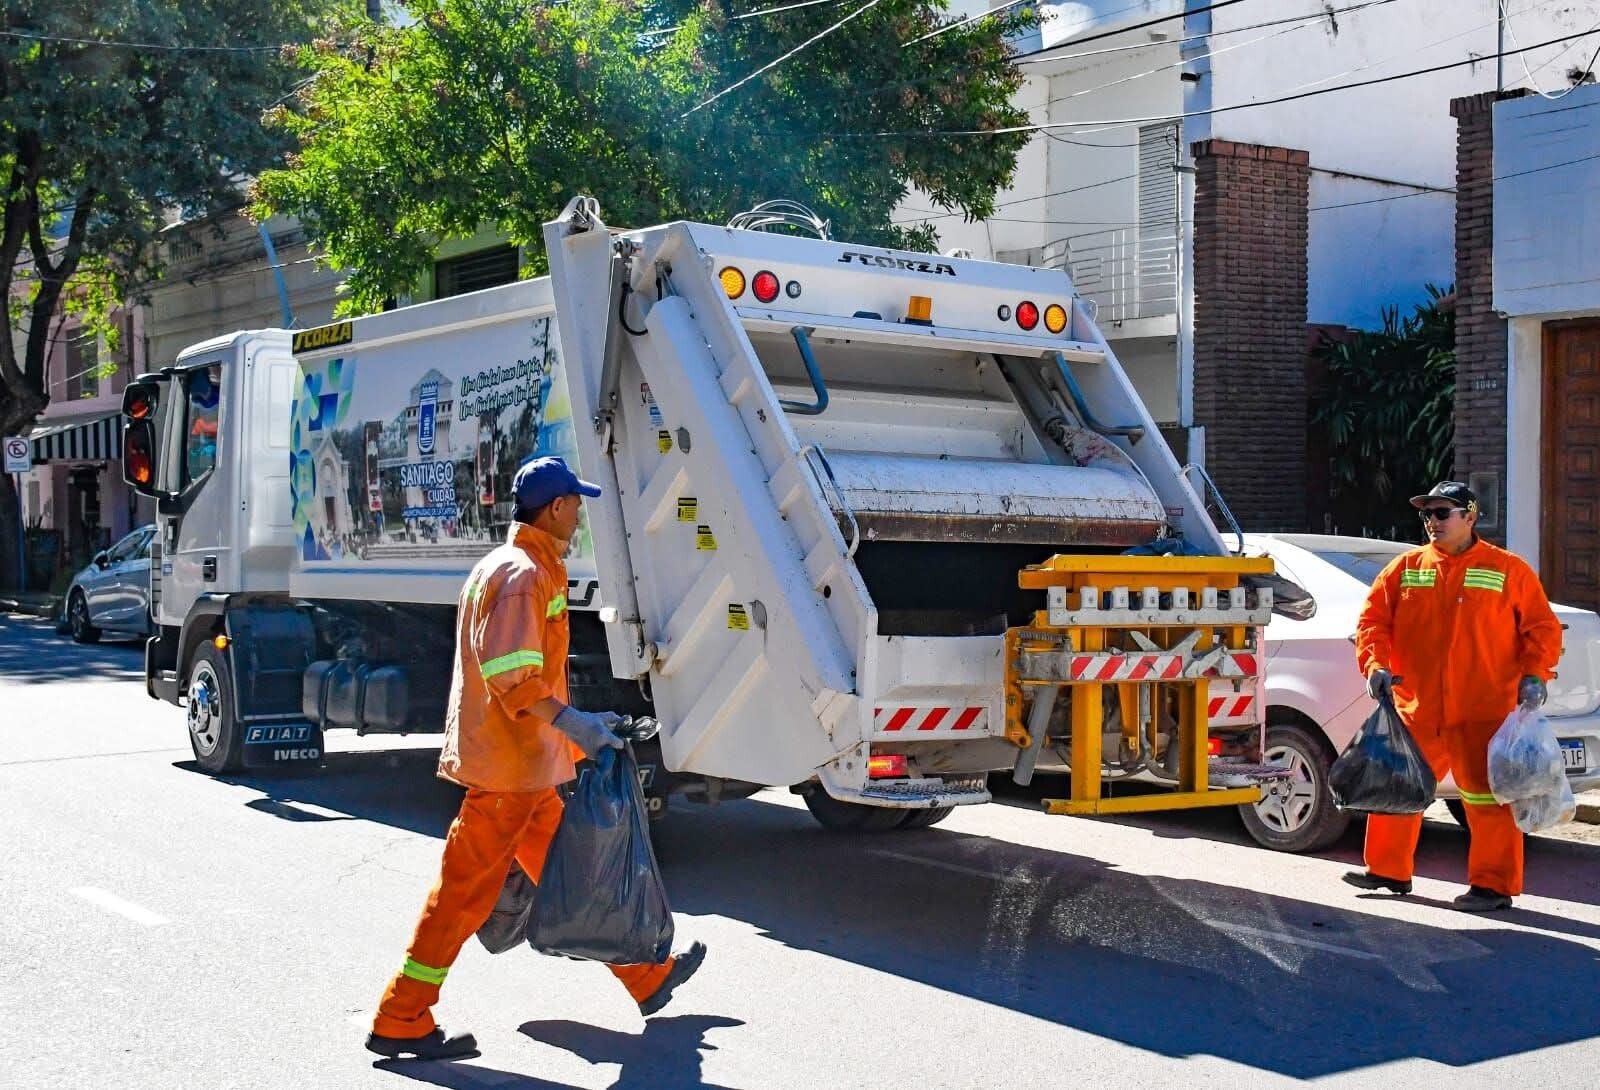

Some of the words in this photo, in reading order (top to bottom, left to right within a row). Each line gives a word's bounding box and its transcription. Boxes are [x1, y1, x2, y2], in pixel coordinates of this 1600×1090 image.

[838, 252, 957, 276] SCORZA
[400, 461, 454, 487] SANTIAGO
[427, 488, 455, 502] CIUDAD
[251, 727, 307, 740] FIAT
[274, 748, 319, 760] IVECO
